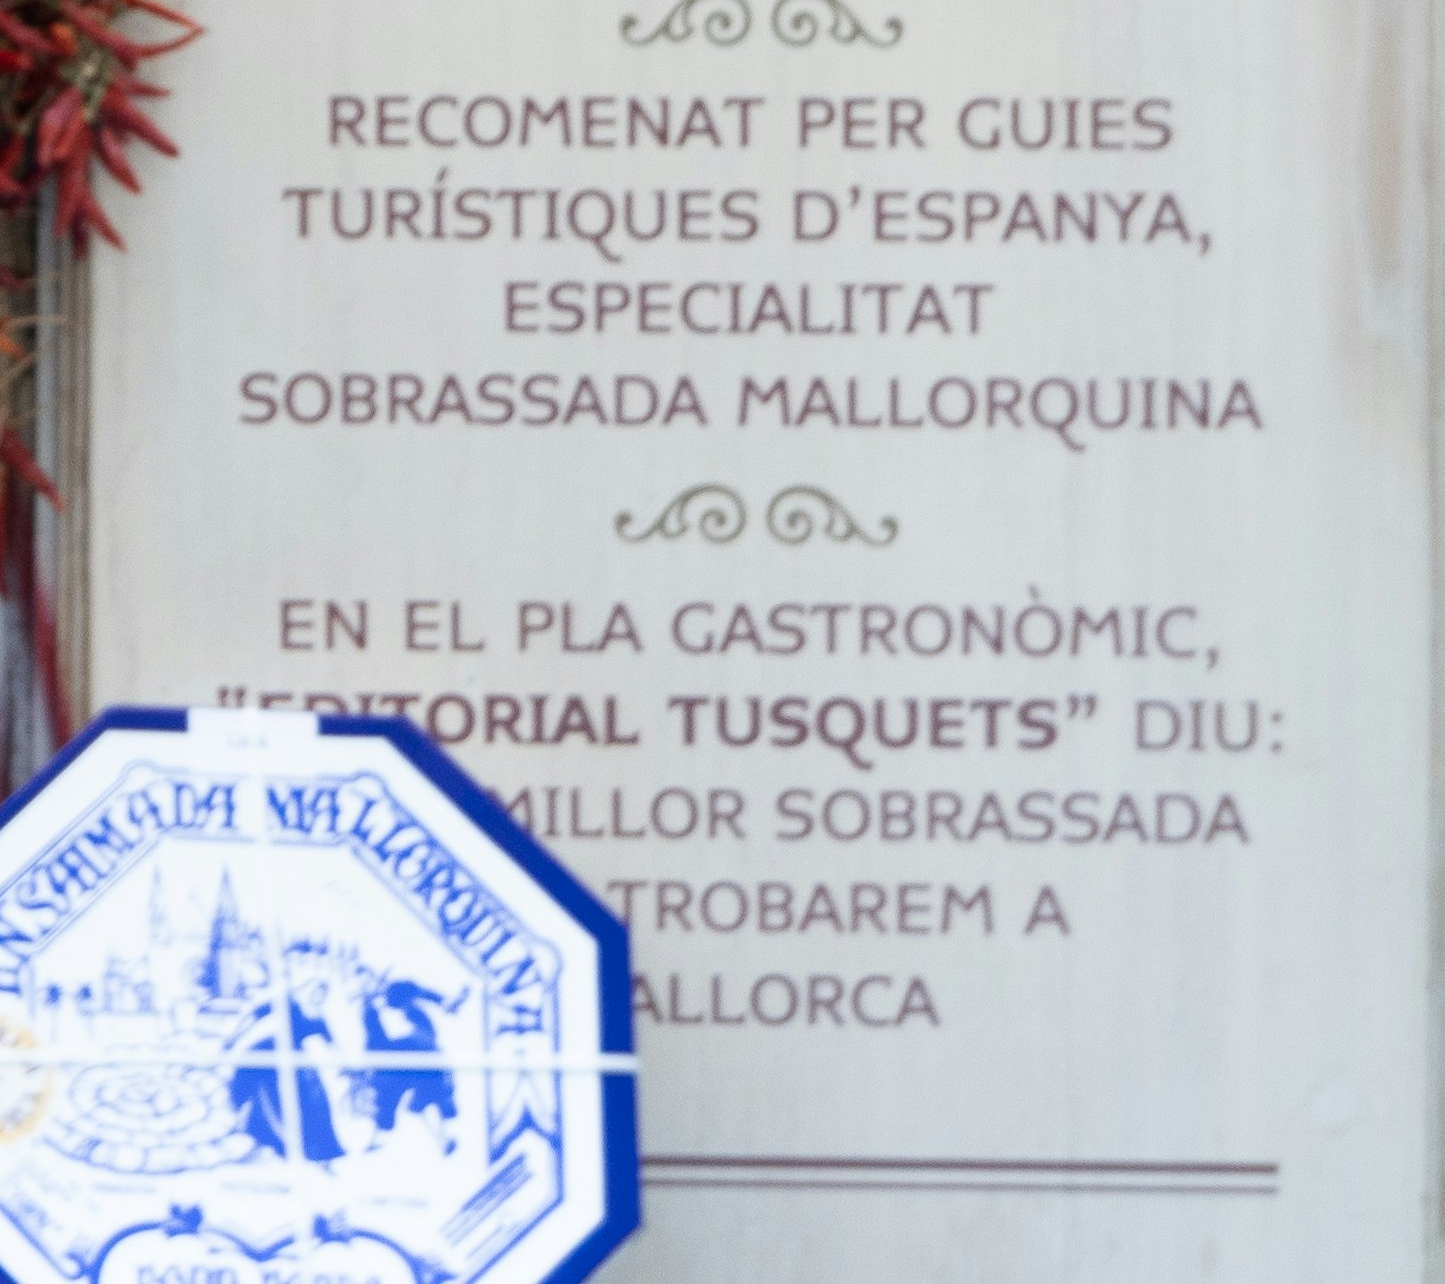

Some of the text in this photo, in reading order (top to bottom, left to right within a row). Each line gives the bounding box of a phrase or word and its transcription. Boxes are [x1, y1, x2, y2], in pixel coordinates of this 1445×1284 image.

[328, 95, 1174, 152] RECOMENAT PER GUIES
[281, 167, 1212, 263] TURÍSTIQUES D'ESPANYA,
[504, 281, 994, 335] ESPECIALITAT
[239, 372, 1264, 453] SOBRASSADA MALLORQUINA
[278, 587, 1219, 669] EN EL PLA GASTRONÒMIC,
[1136, 700, 1285, 754] DIU:
[775, 788, 1251, 845] SOBRASSADA
[607, 879, 1071, 936] TROBAREM A
